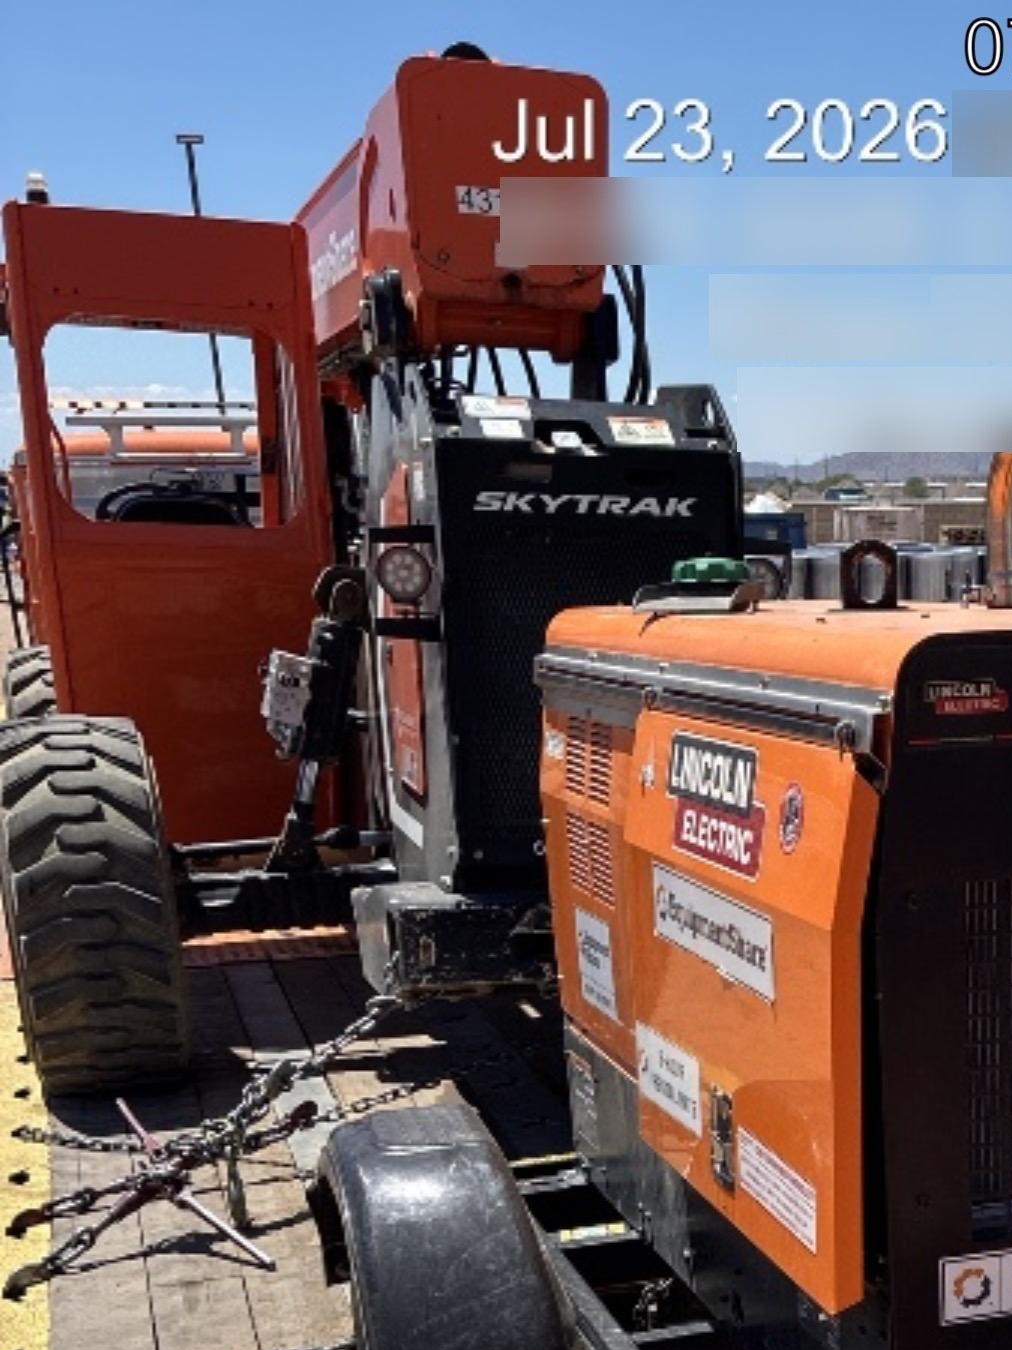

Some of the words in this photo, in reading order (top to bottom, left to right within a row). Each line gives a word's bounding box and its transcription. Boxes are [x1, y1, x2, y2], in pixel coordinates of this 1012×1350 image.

[473, 491, 697, 517] SKYTRAK
[929, 683, 992, 698] LINCOLN
[672, 743, 753, 808] LINCOLN
[681, 809, 754, 865] ELECTRIC
